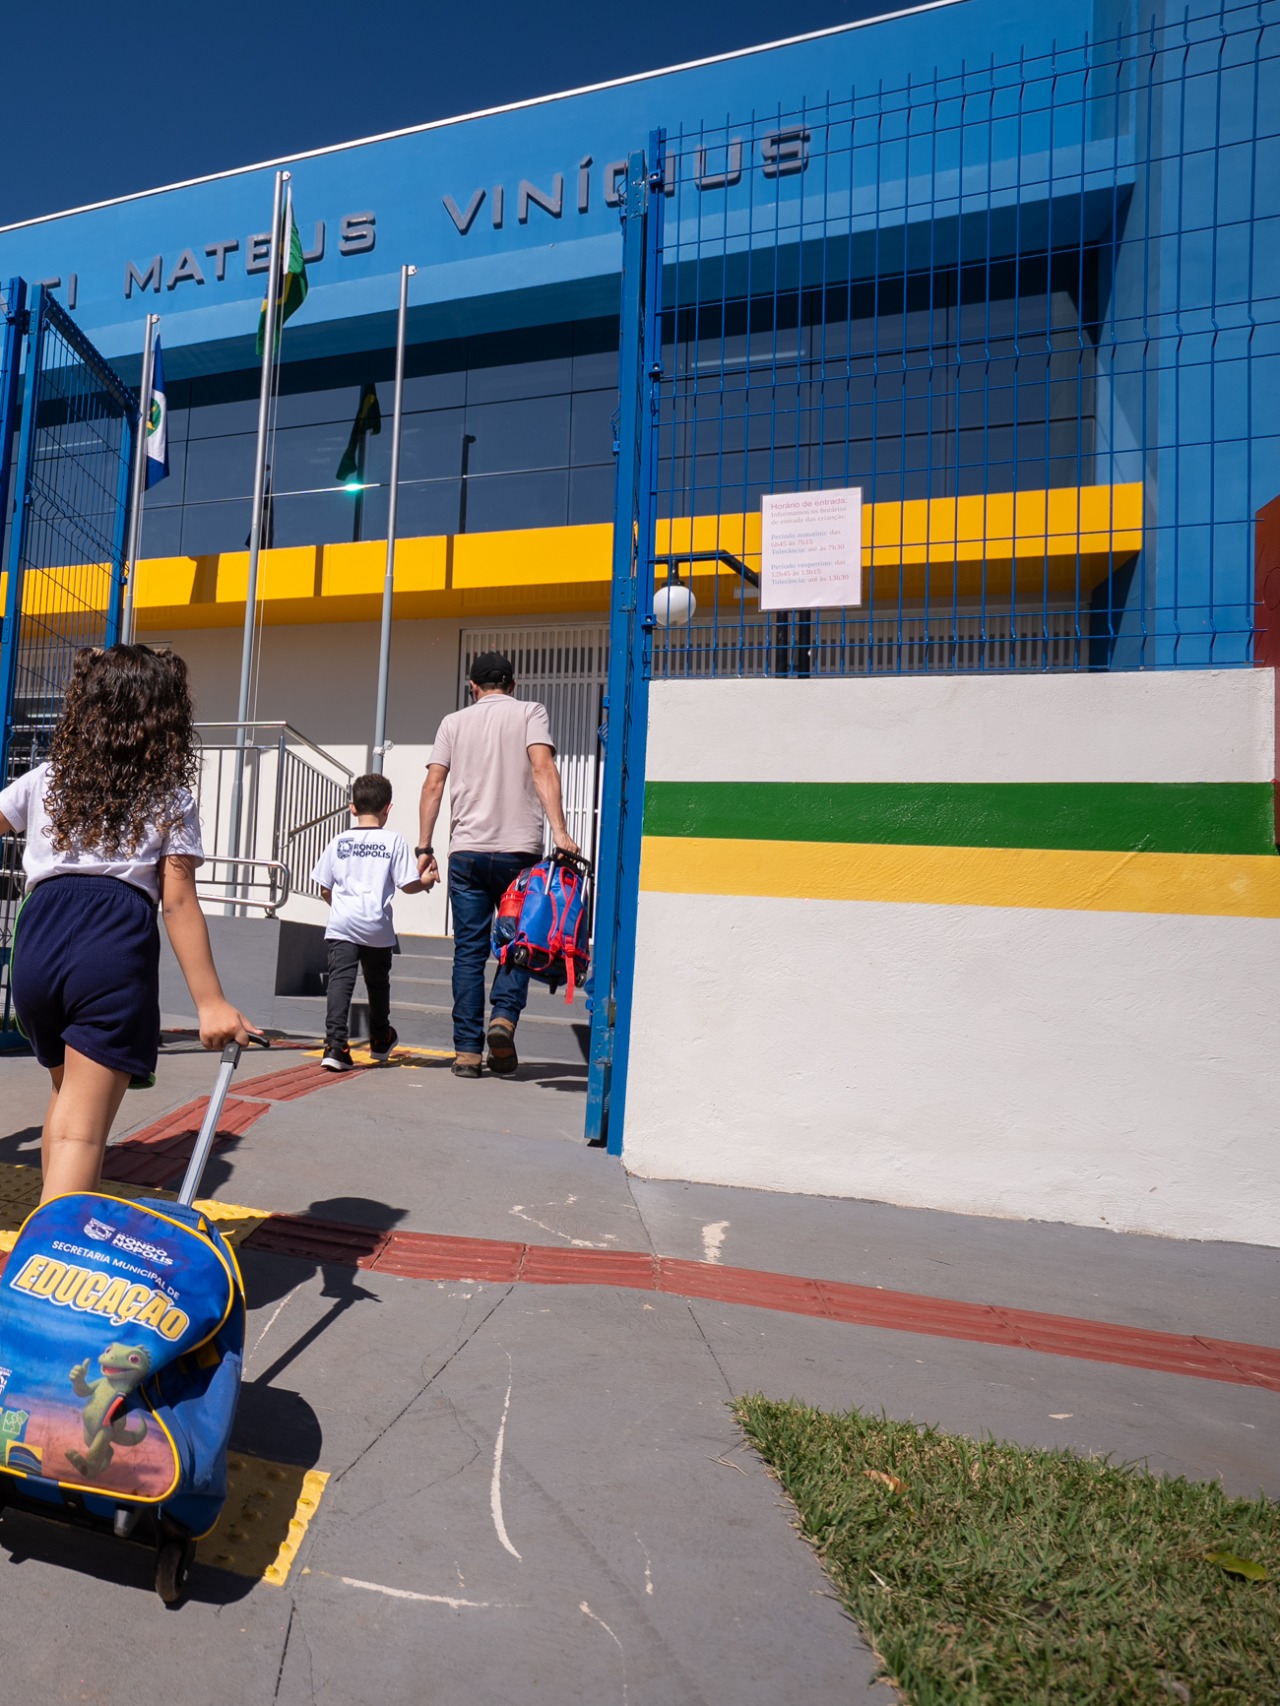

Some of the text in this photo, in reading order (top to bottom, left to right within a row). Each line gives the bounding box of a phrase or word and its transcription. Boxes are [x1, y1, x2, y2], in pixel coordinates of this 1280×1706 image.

[51, 1240, 111, 1264] SECRETARIA
[112, 1258, 165, 1290] MUNICIPAL
[166, 1287, 180, 1300] DE
[116, 1233, 168, 1257] RONDO
[13, 1255, 187, 1340] EDUCAÇÃO
